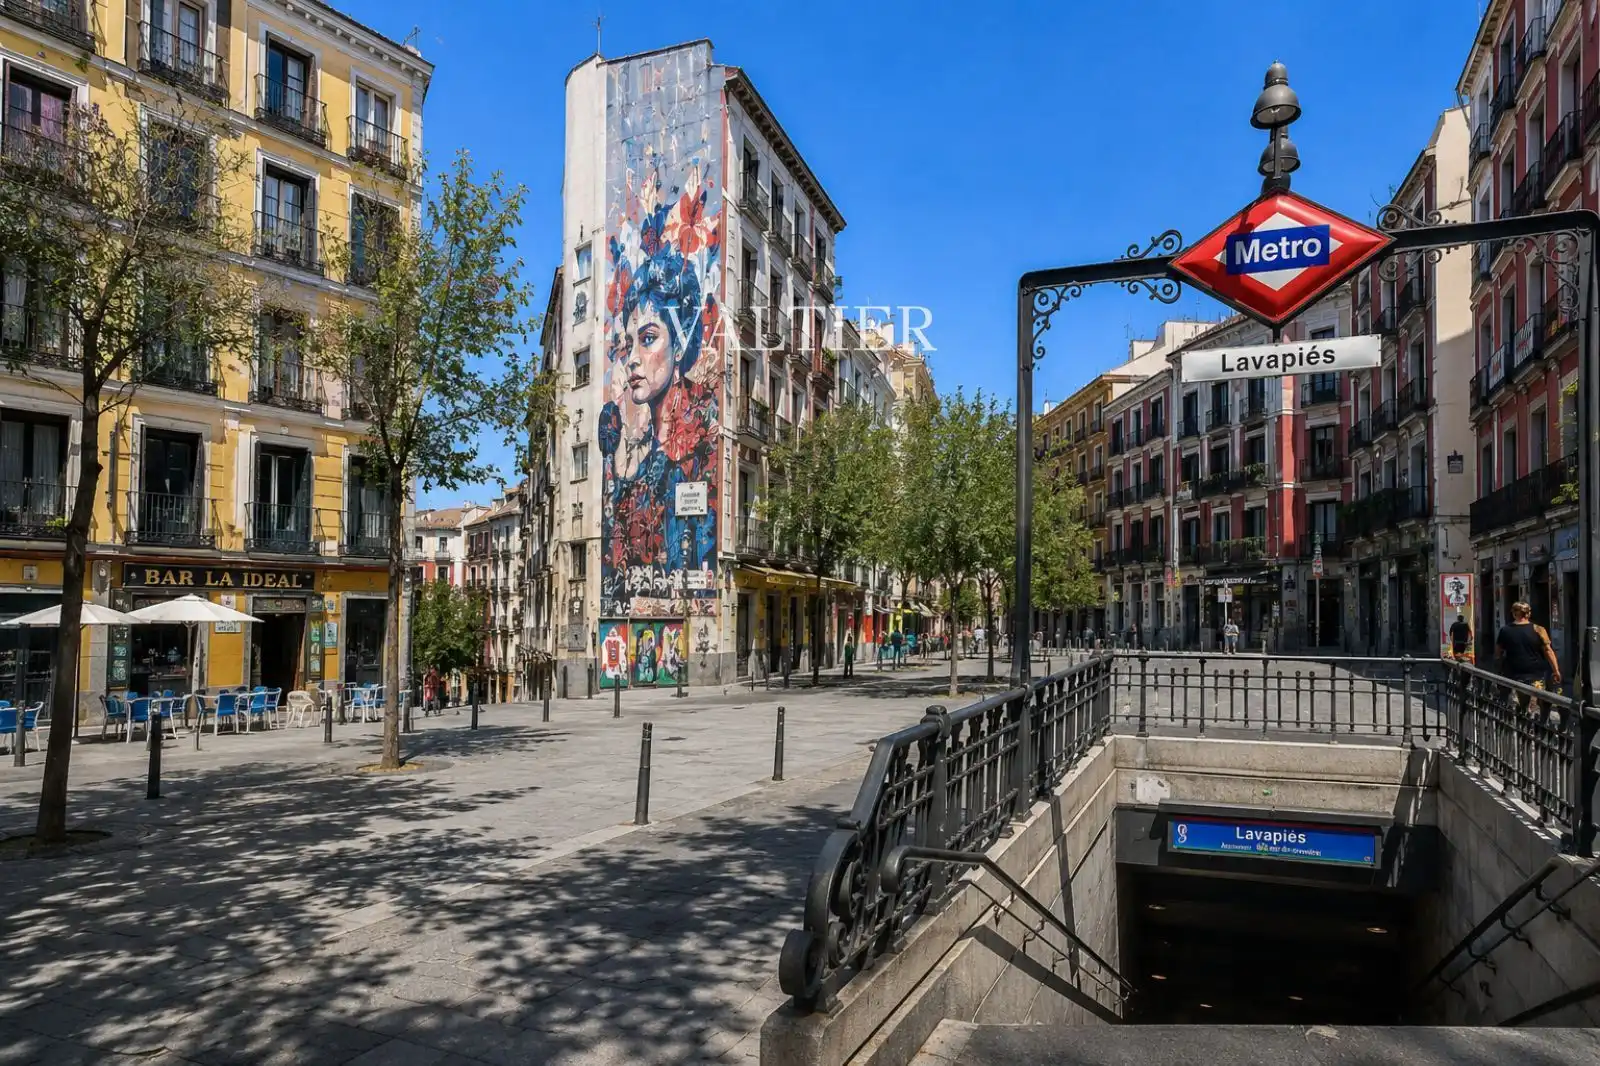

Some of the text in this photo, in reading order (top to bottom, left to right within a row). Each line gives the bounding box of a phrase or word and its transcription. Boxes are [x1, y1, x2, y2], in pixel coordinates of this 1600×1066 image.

[1235, 236, 1322, 265] Metro
[1221, 345, 1336, 373] Lavapiés
[144, 569, 302, 588] BAR LA IDEAL
